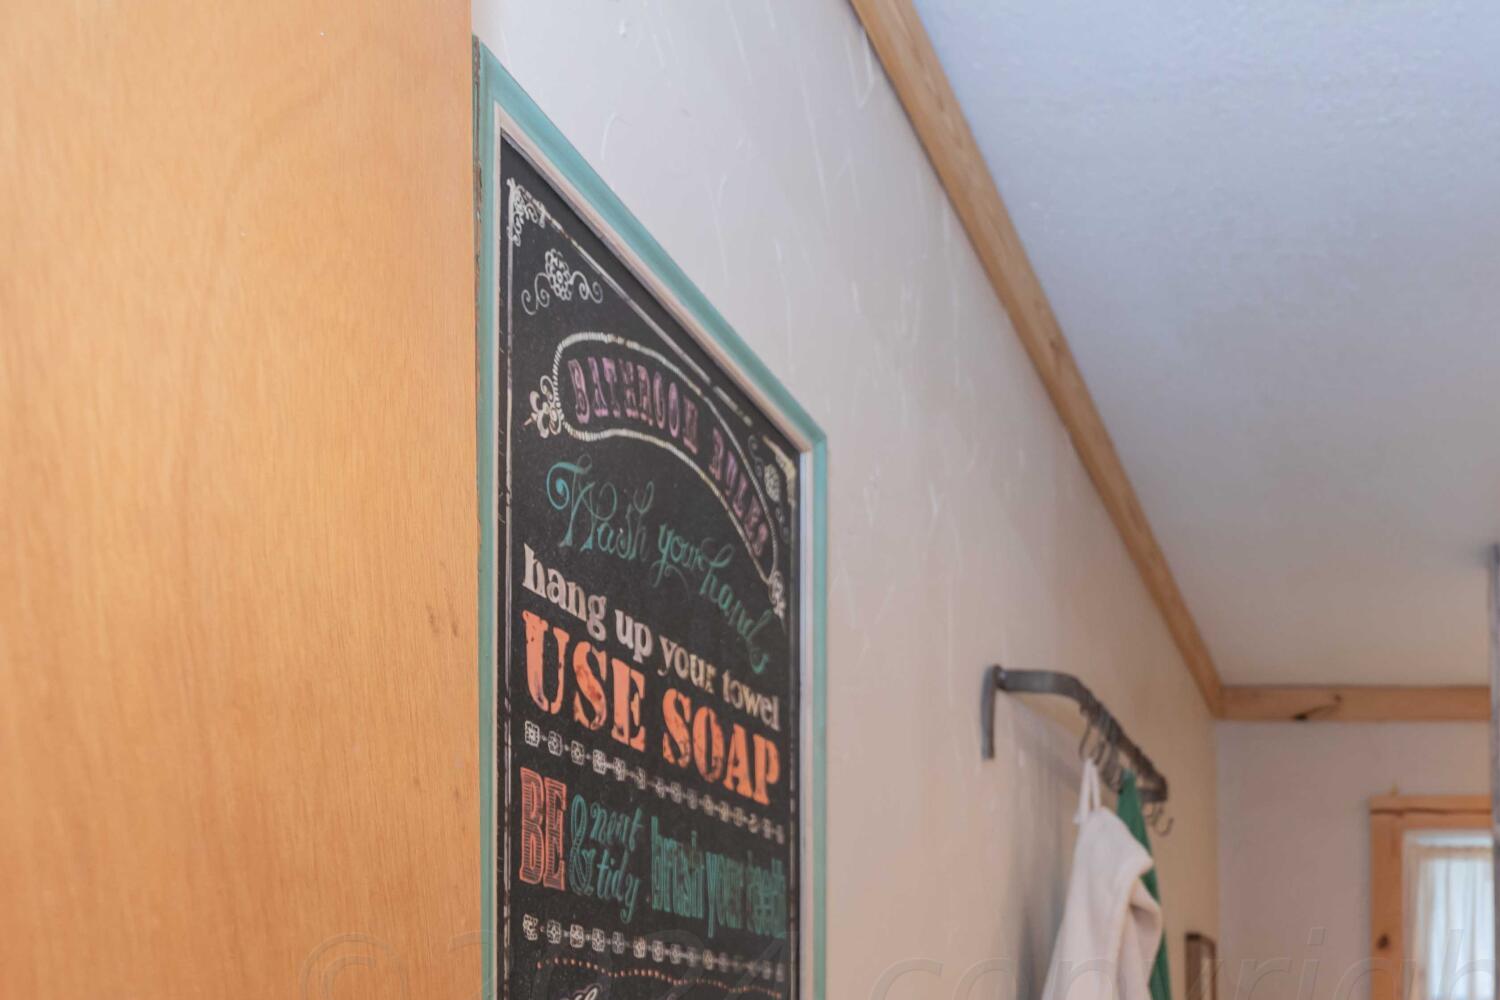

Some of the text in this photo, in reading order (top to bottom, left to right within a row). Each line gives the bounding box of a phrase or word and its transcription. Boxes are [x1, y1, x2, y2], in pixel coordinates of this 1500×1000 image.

[568, 356, 768, 556] BATHROOM RULES
[522, 543, 780, 731] hang up your towel
[546, 452, 774, 675] Wash your hands
[522, 610, 780, 805] USE SOAP
[519, 767, 567, 891] BE
[590, 802, 643, 851] neat
[597, 848, 641, 925] tidy
[651, 815, 704, 919] brush
